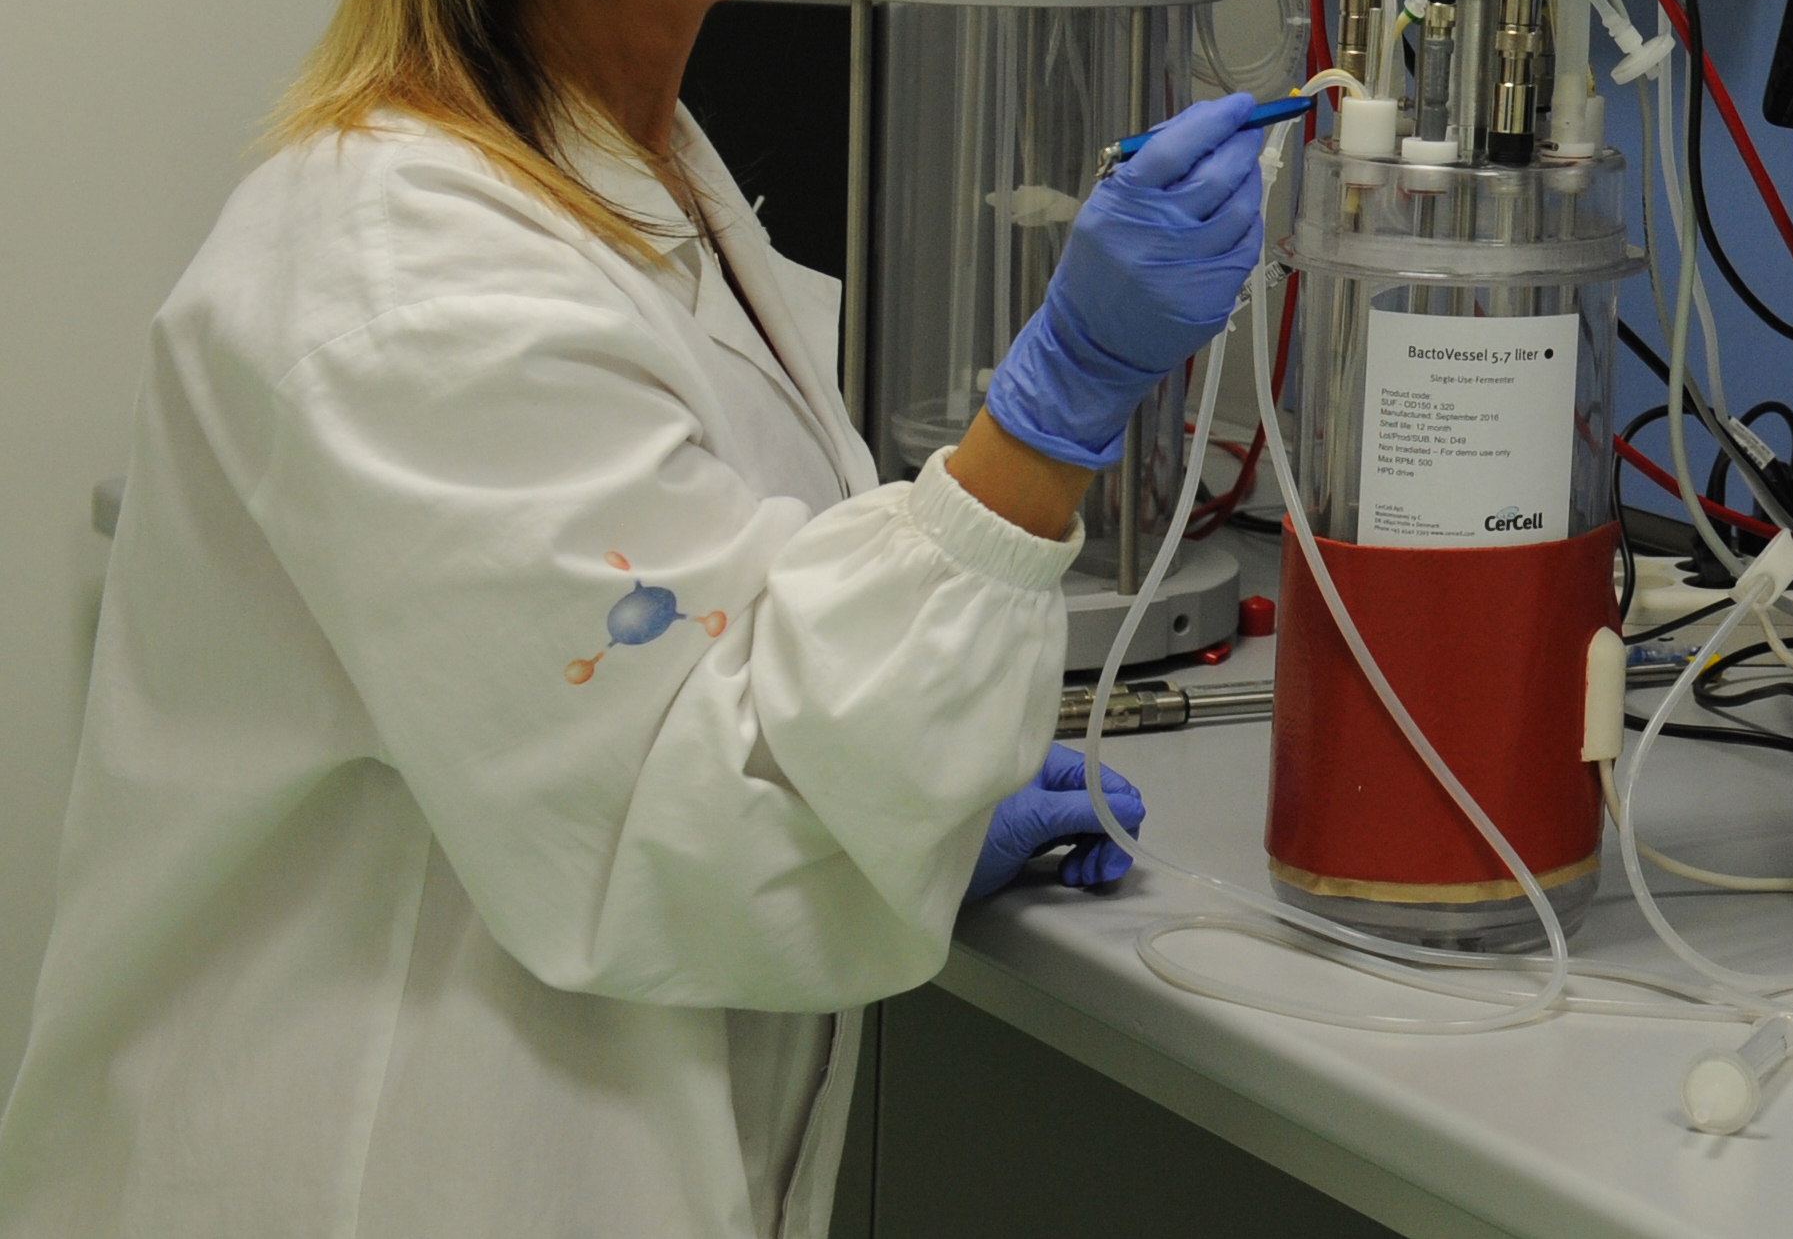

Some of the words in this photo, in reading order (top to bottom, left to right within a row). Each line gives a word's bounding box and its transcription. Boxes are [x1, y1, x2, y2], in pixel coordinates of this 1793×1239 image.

[1408, 346, 1487, 361] BactoVessel
[1492, 352, 1511, 363] 5.7
[1515, 348, 1538, 360] liter
[1381, 388, 1409, 399] Product
[1436, 412, 1478, 422] September
[1416, 423, 1425, 431] 12
[1427, 424, 1452, 432] month
[1440, 448, 1454, 456] For
[1456, 449, 1477, 457] demo
[1495, 449, 1511, 458] only
[1485, 513, 1543, 532] CerCell
